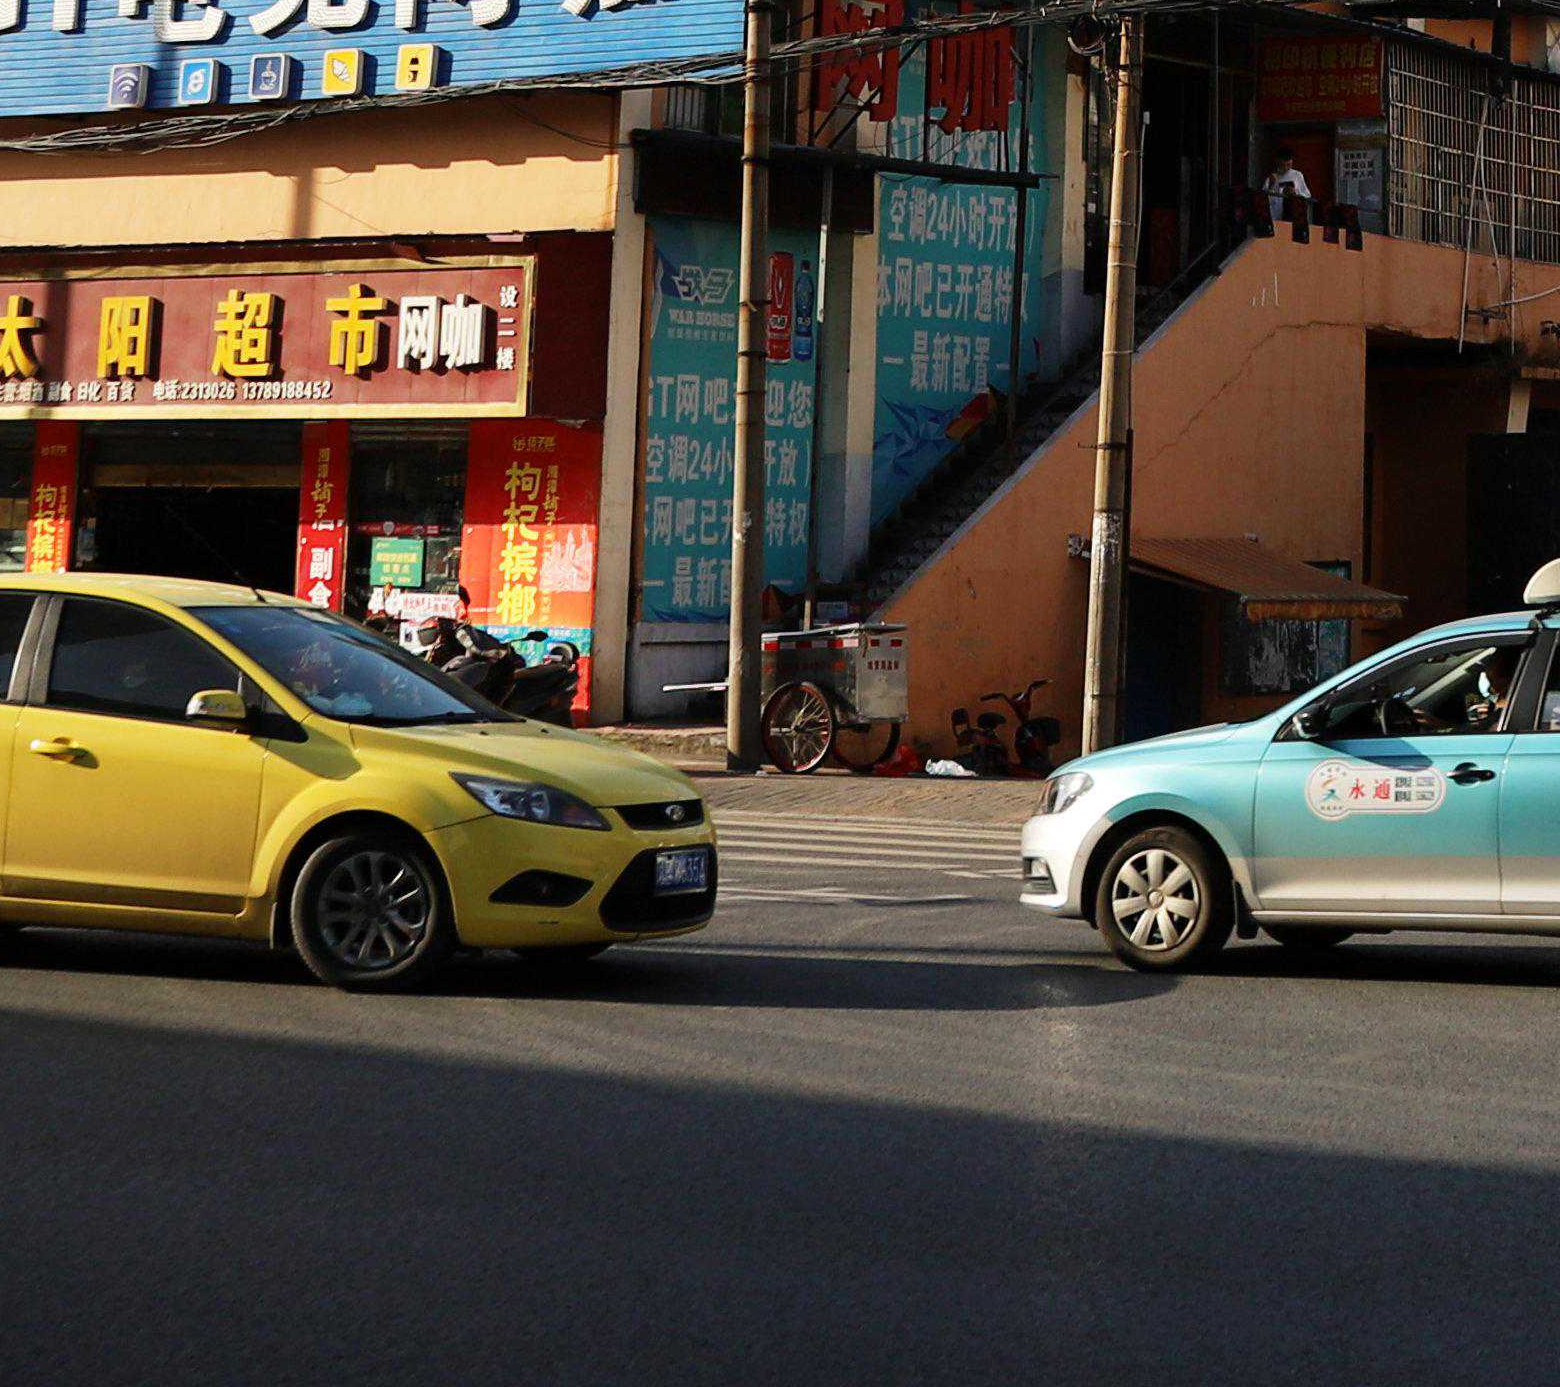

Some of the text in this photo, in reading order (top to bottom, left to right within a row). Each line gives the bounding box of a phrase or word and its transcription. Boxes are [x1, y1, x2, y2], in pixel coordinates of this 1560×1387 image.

[397, 292, 486, 370] 网咖
[498, 284, 518, 370] 设二楼
[496, 461, 542, 626] 枸杞槟榔
[1349, 778, 1391, 800] 永通
